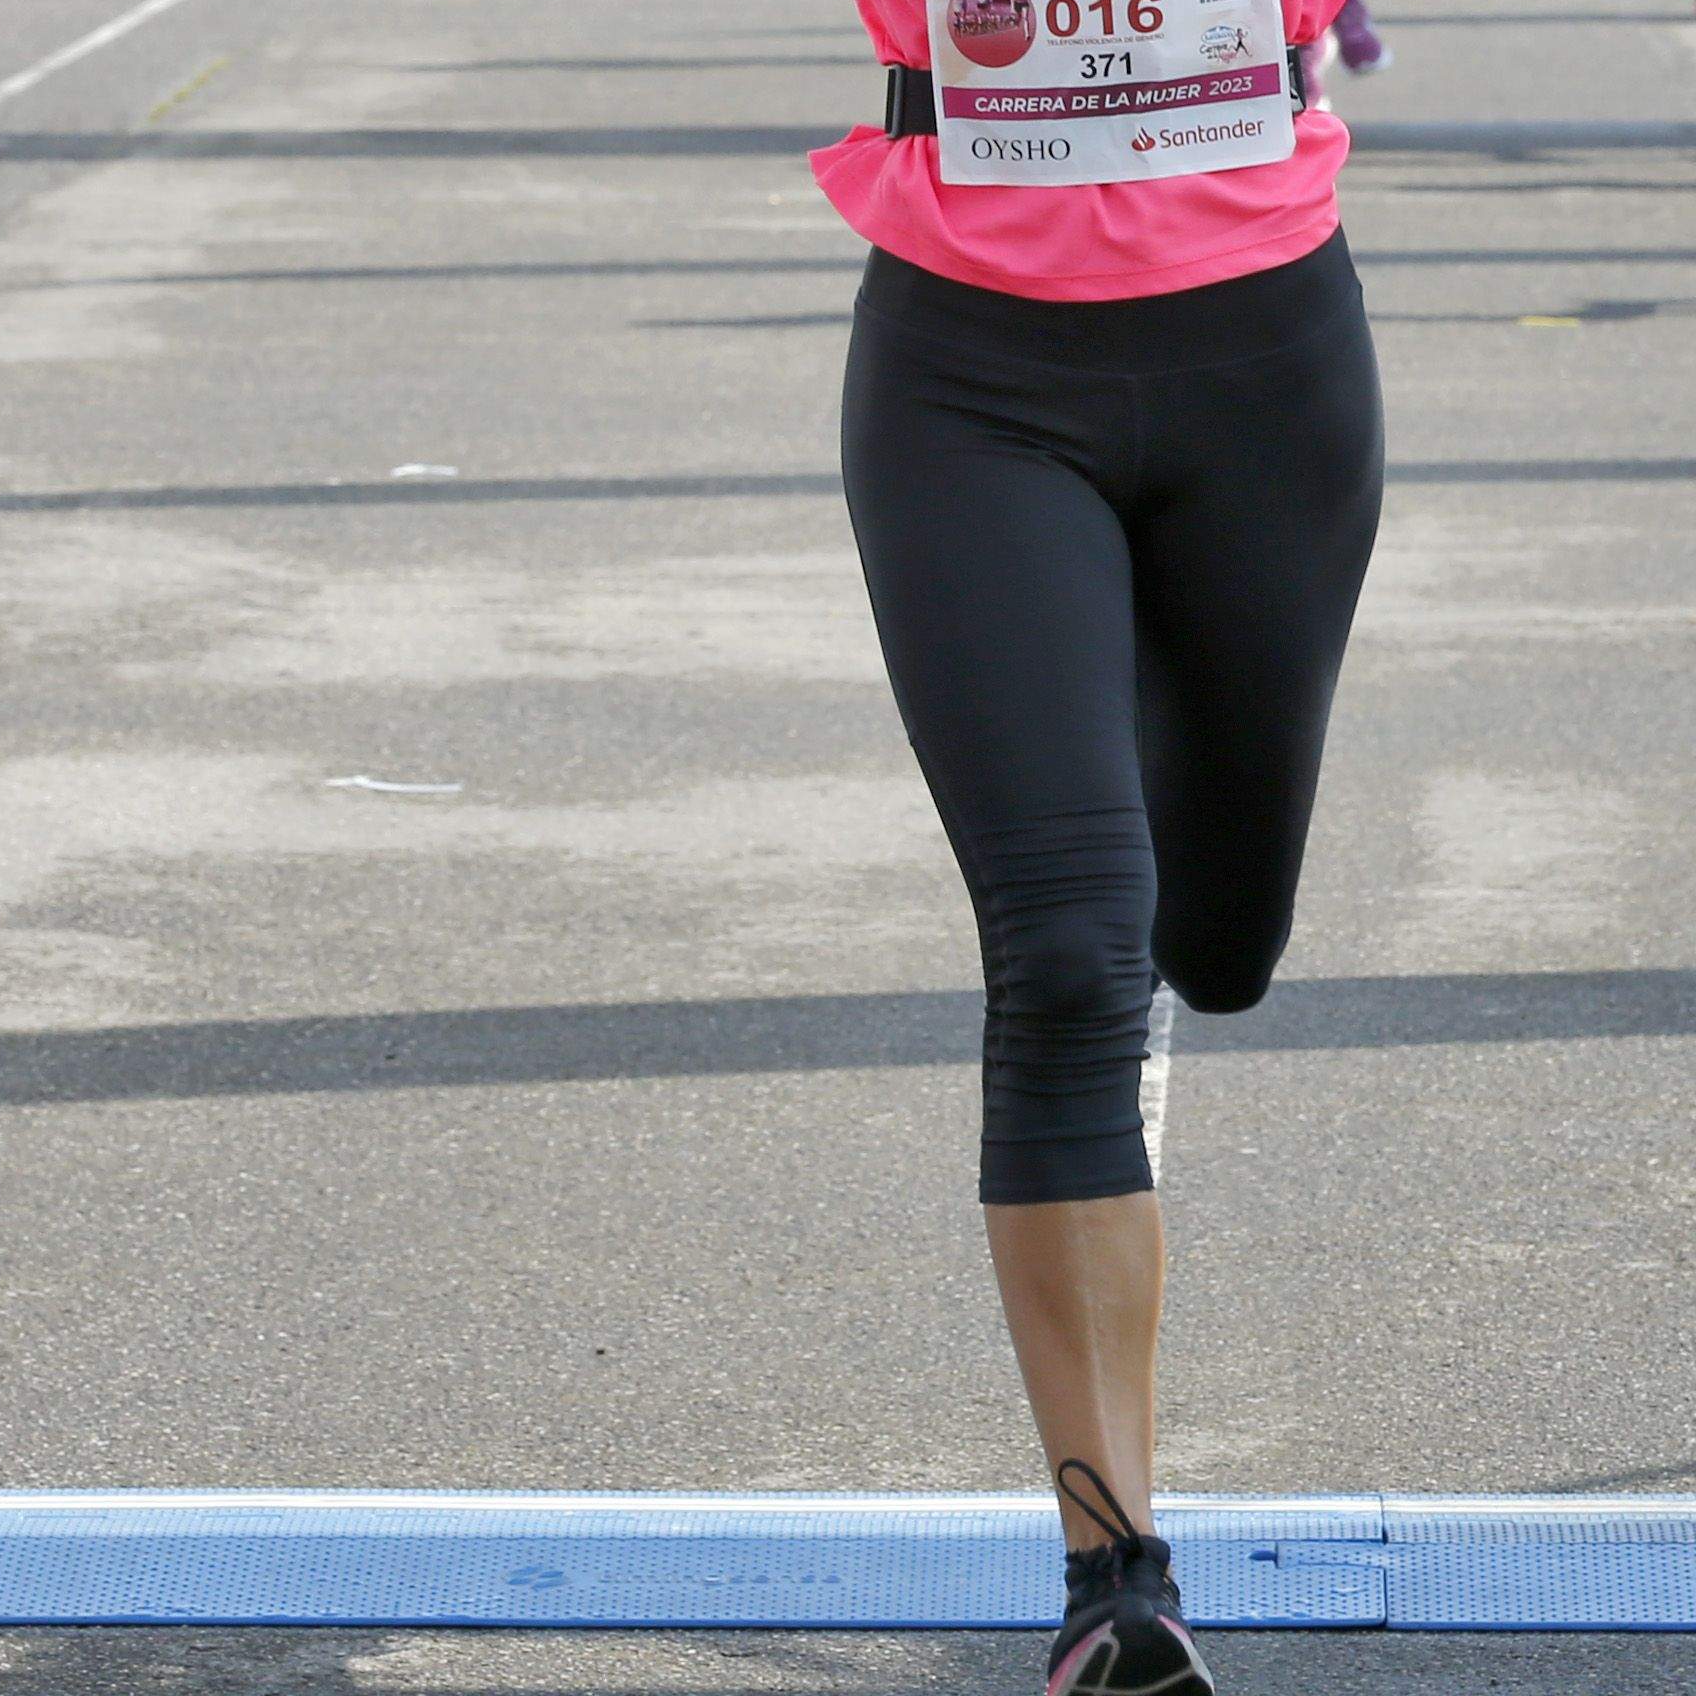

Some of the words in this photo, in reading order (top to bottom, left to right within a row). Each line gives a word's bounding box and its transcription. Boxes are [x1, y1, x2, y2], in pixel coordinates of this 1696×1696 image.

[1081, 52, 1132, 79] 371
[975, 96, 1065, 112] CARRERA
[1072, 95, 1099, 111] DE
[1104, 92, 1130, 108] LA
[1135, 83, 1201, 105] MUJER
[1209, 76, 1253, 96] 2023
[1160, 118, 1265, 149] Santander
[971, 137, 1071, 161] OYSHO
